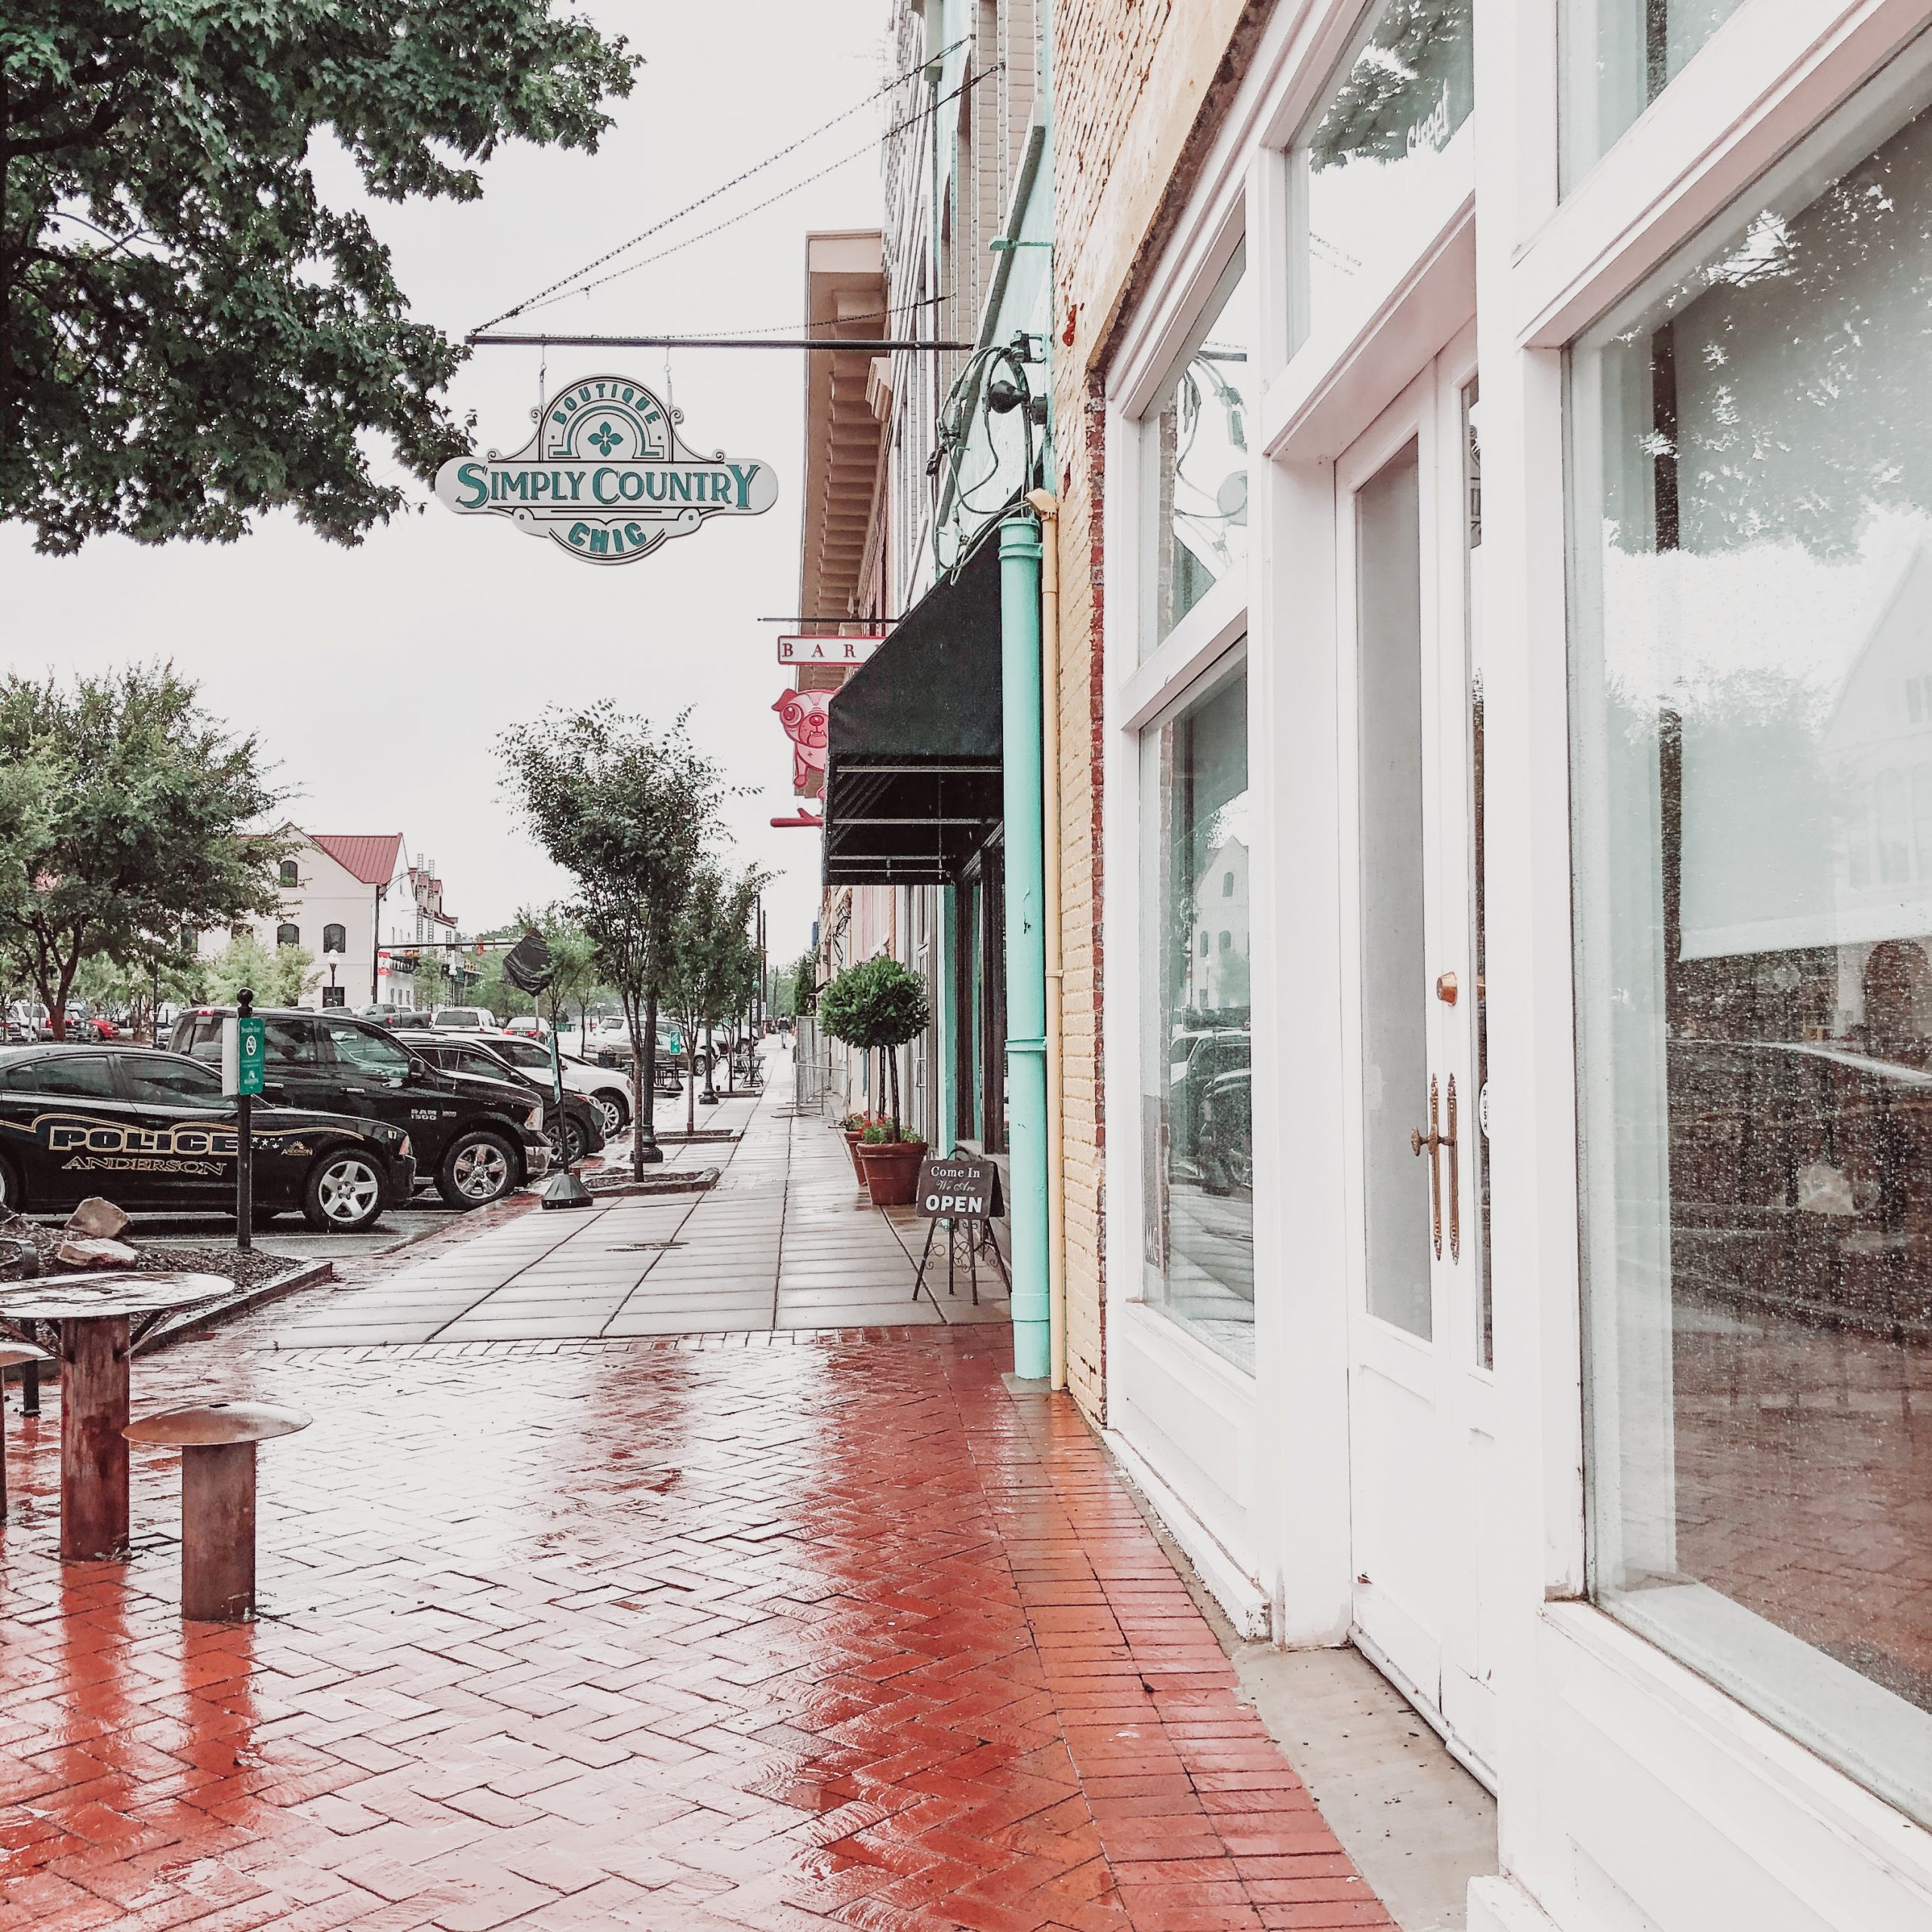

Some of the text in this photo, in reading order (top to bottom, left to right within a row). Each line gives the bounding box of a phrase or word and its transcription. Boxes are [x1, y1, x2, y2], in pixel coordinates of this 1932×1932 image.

[552, 383, 661, 425] BOUTIQUE
[568, 521, 647, 554] CHIC
[782, 643, 881, 658] BAR
[48, 1125, 238, 1156] POLICE
[62, 1155, 227, 1176] ANDERSON
[931, 1166, 980, 1178] Come In
[925, 1195, 983, 1214] OPEN
